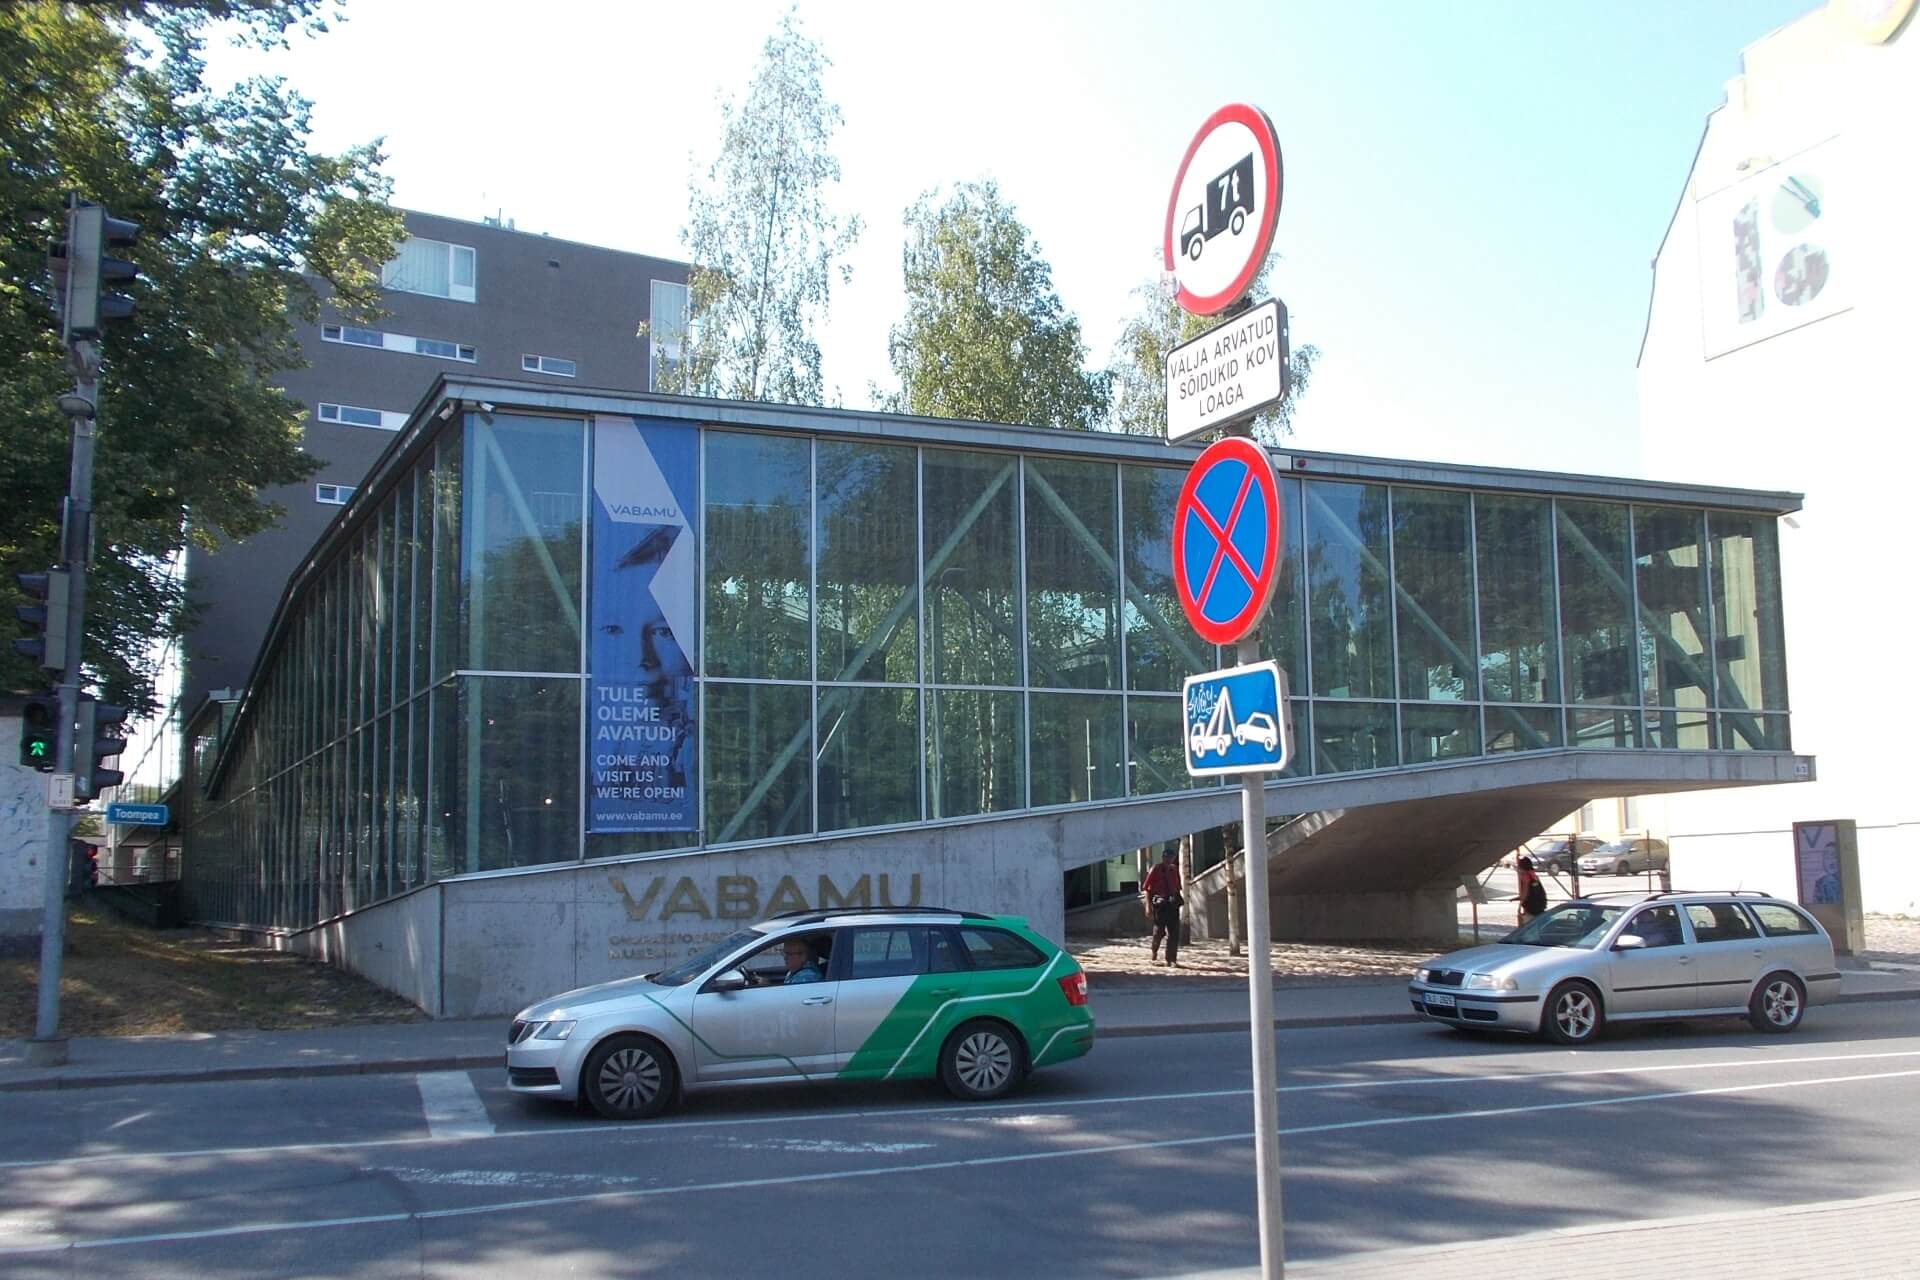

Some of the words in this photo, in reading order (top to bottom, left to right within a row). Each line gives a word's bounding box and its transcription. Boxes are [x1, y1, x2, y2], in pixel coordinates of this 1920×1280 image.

[1217, 169, 1240, 211] 7t
[1170, 347, 1208, 379] VÄLJA
[1214, 315, 1274, 360] ARVATUD
[1180, 359, 1239, 400] SÕIDUKID
[1246, 340, 1275, 371] KOV
[1199, 383, 1244, 417] LOAGA
[610, 504, 677, 518] VABAMU
[597, 686, 648, 705] TULE,
[597, 706, 661, 722] OLEME
[597, 725, 676, 742] AVATUD!
[596, 754, 637, 767] COME
[640, 755, 670, 767] AND
[597, 771, 632, 783] VISIT
[635, 771, 654, 782] US
[596, 787, 641, 799] WE'RE
[644, 787, 684, 799] OPEN!
[115, 807, 160, 821] Toompea
[596, 811, 683, 821] www.vabamu.ee
[607, 872, 921, 921] VABAMU
